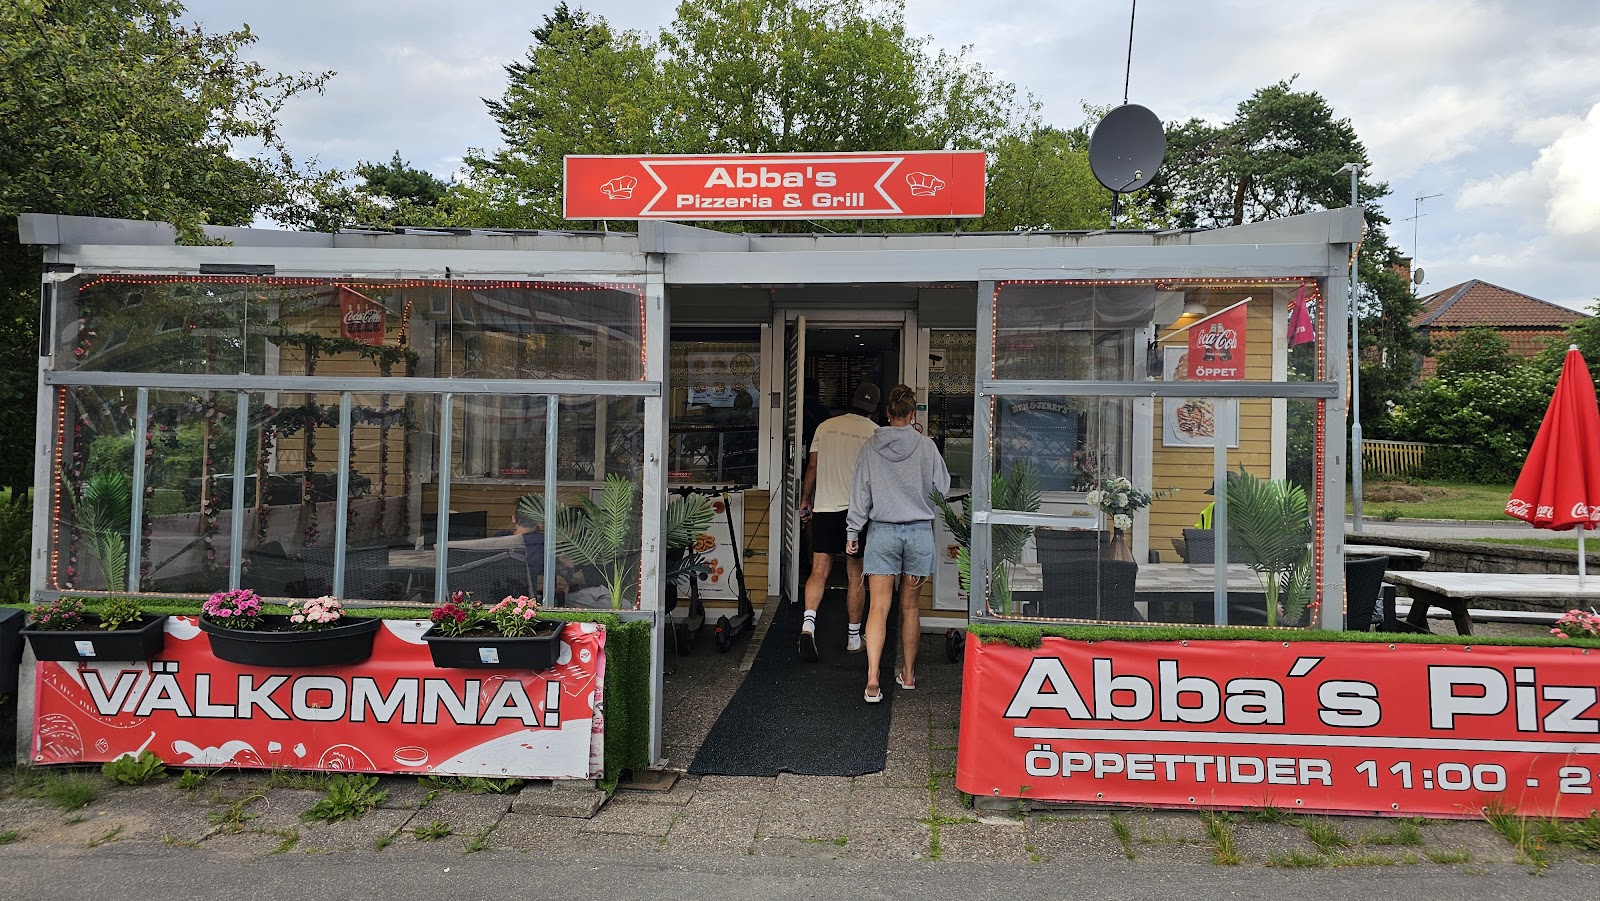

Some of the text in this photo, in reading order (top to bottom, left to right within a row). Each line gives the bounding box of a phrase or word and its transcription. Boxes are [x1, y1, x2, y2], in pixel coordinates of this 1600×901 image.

[704, 166, 837, 188] Abba's
[676, 192, 865, 209] Pizzeria & Grill
[343, 309, 382, 324] Coca-Cola
[1196, 366, 1237, 377] ÖPPET
[1011, 403, 1029, 414] BEN
[1036, 401, 1068, 415] JERRY'S
[82, 661, 563, 730] VÄLKOMNA!
[1024, 743, 1333, 787] ÖPPETTIDER
[1355, 760, 1508, 794] 11:00
[1558, 765, 1600, 795] 2
